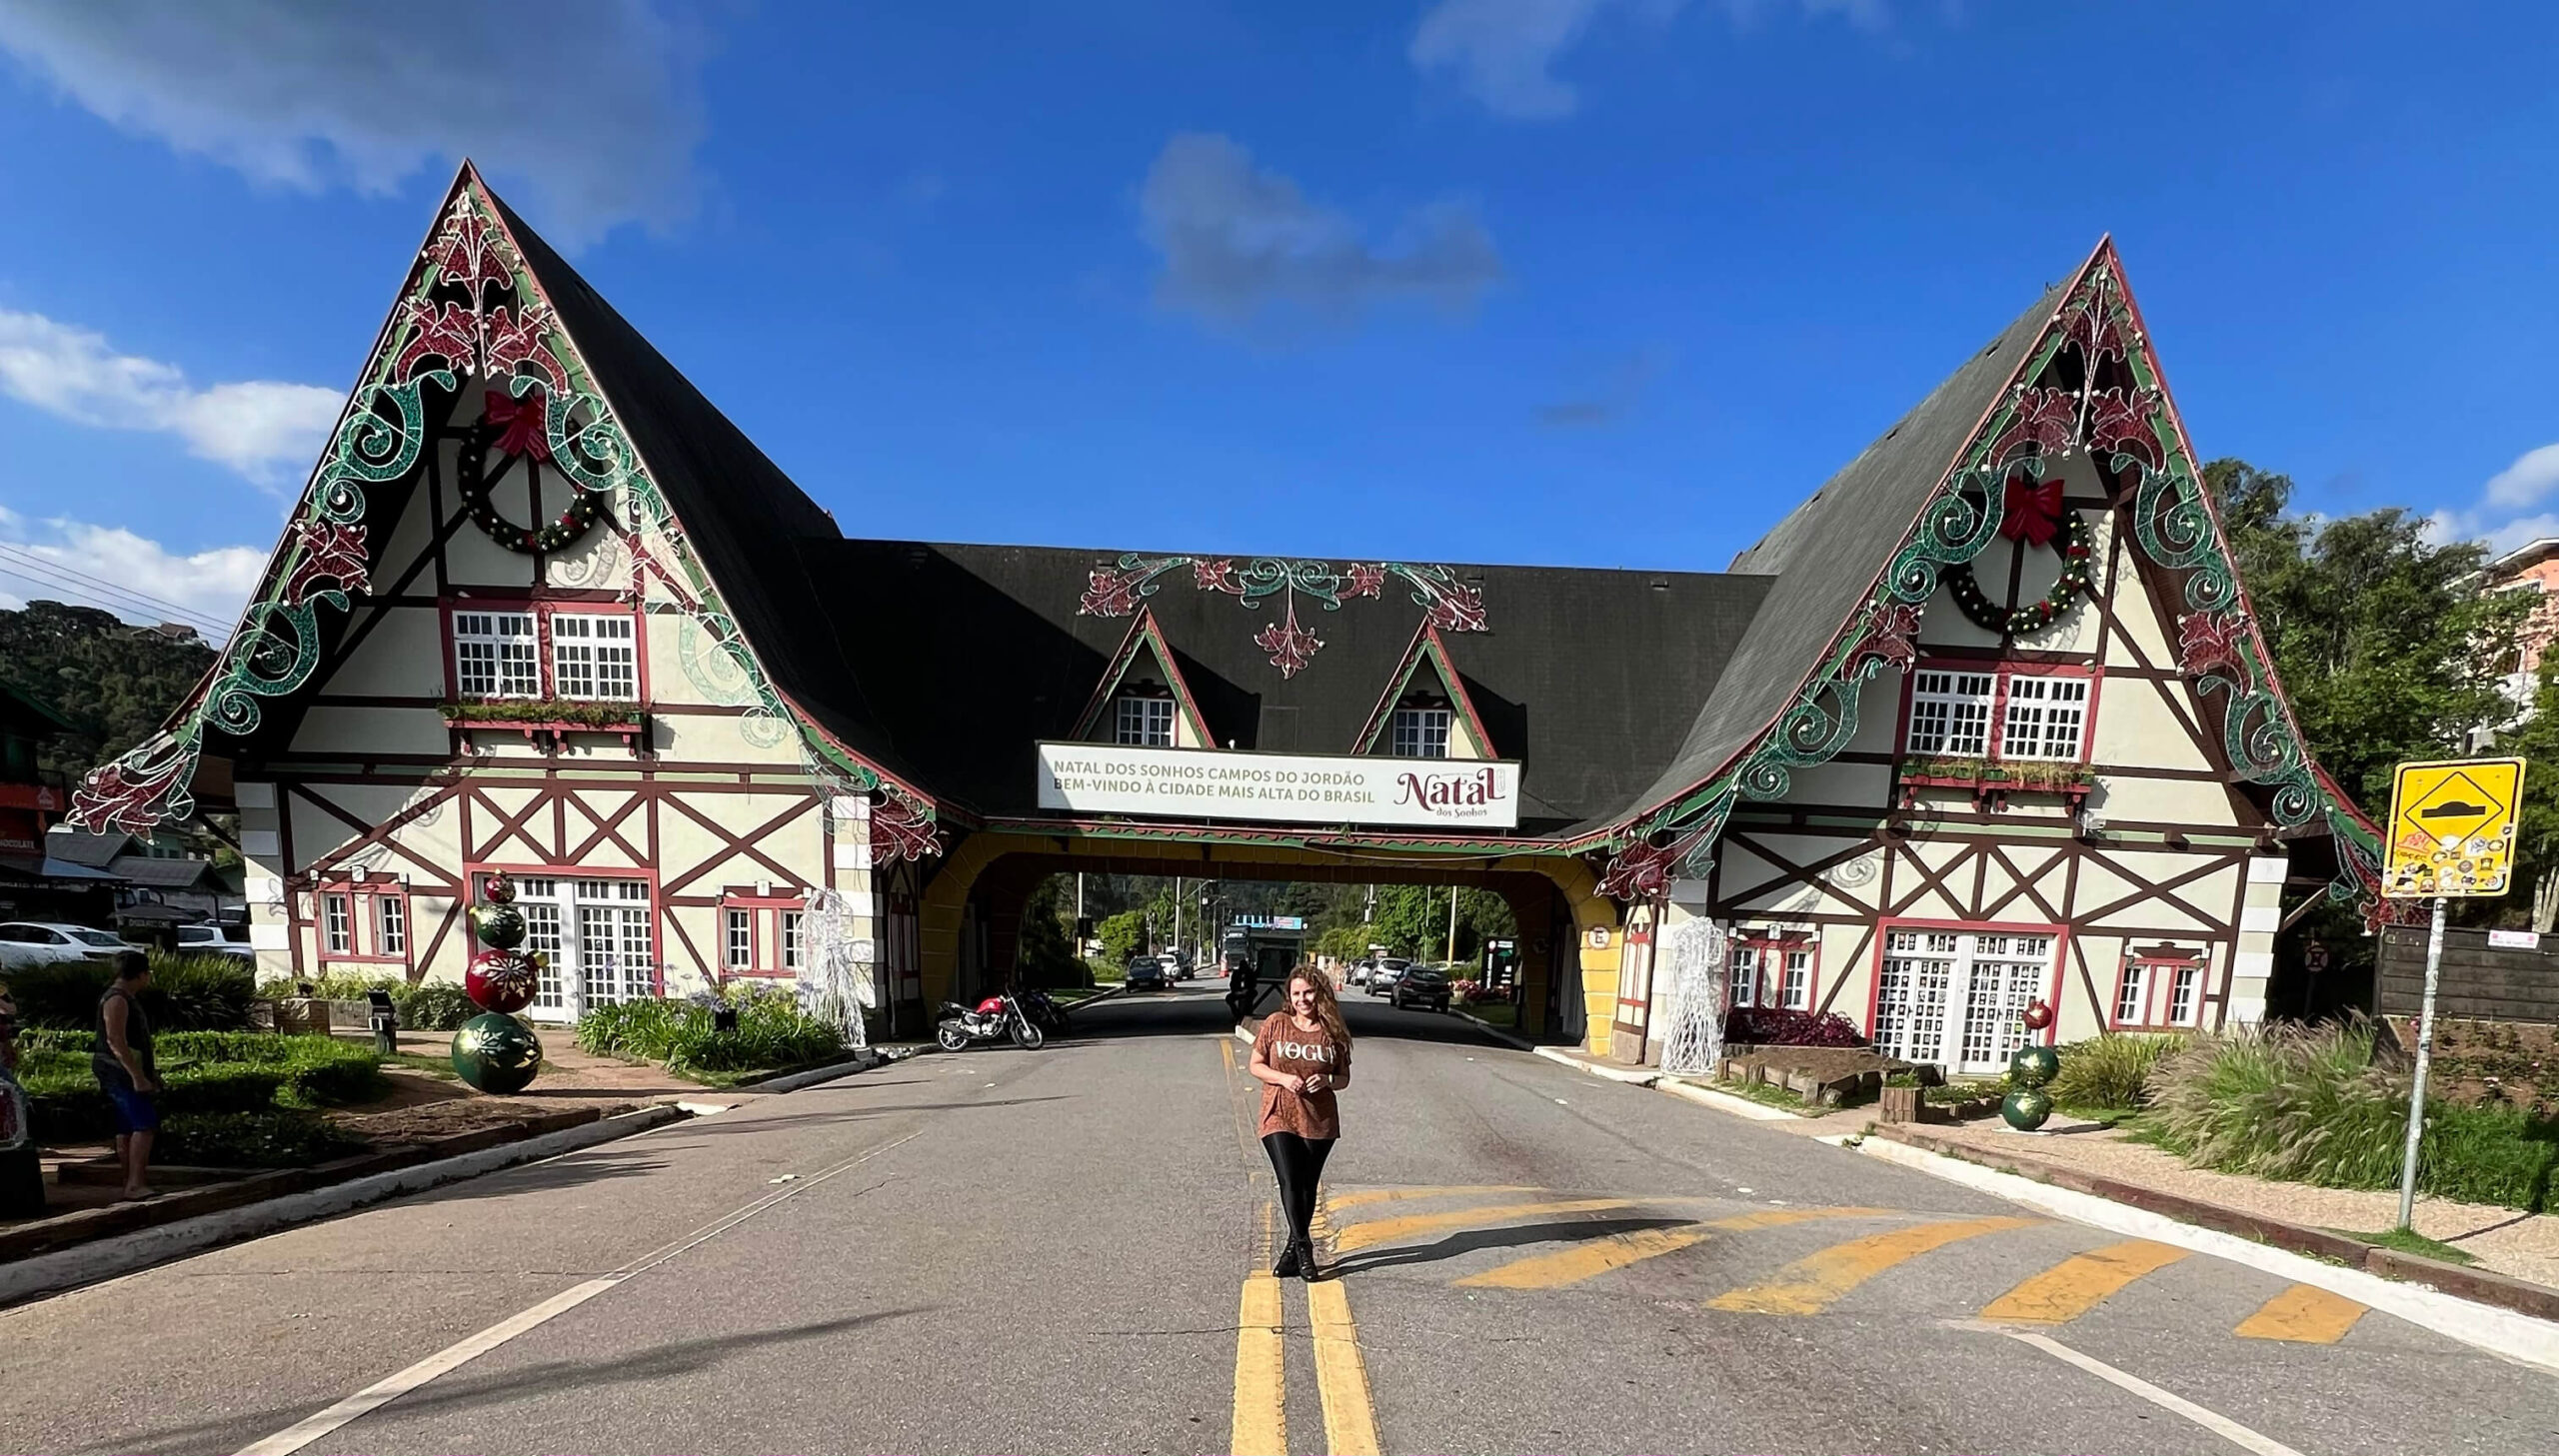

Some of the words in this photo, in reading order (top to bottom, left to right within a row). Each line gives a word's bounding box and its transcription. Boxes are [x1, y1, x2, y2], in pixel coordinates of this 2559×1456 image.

[1054, 760, 1101, 774] NATAL
[1105, 762, 1137, 775] DOS
[1141, 764, 1205, 778] SONHOS
[1208, 767, 1272, 782] CAMPOS
[1276, 770, 1297, 783] DO
[1301, 770, 1364, 786] JORDÃO
[1054, 777, 1142, 793] BEM-VINDO
[1145, 777, 1156, 794] À
[1159, 782, 1215, 796] CIDADE
[1219, 785, 1255, 798] MAIS
[1258, 787, 1294, 800] ALTA
[1297, 788, 1320, 802] DO
[1324, 790, 1375, 803] BRASIL
[1393, 767, 1506, 811] Natal
[1435, 806, 1452, 817] dos
[1454, 807, 1487, 818] Sonhos
